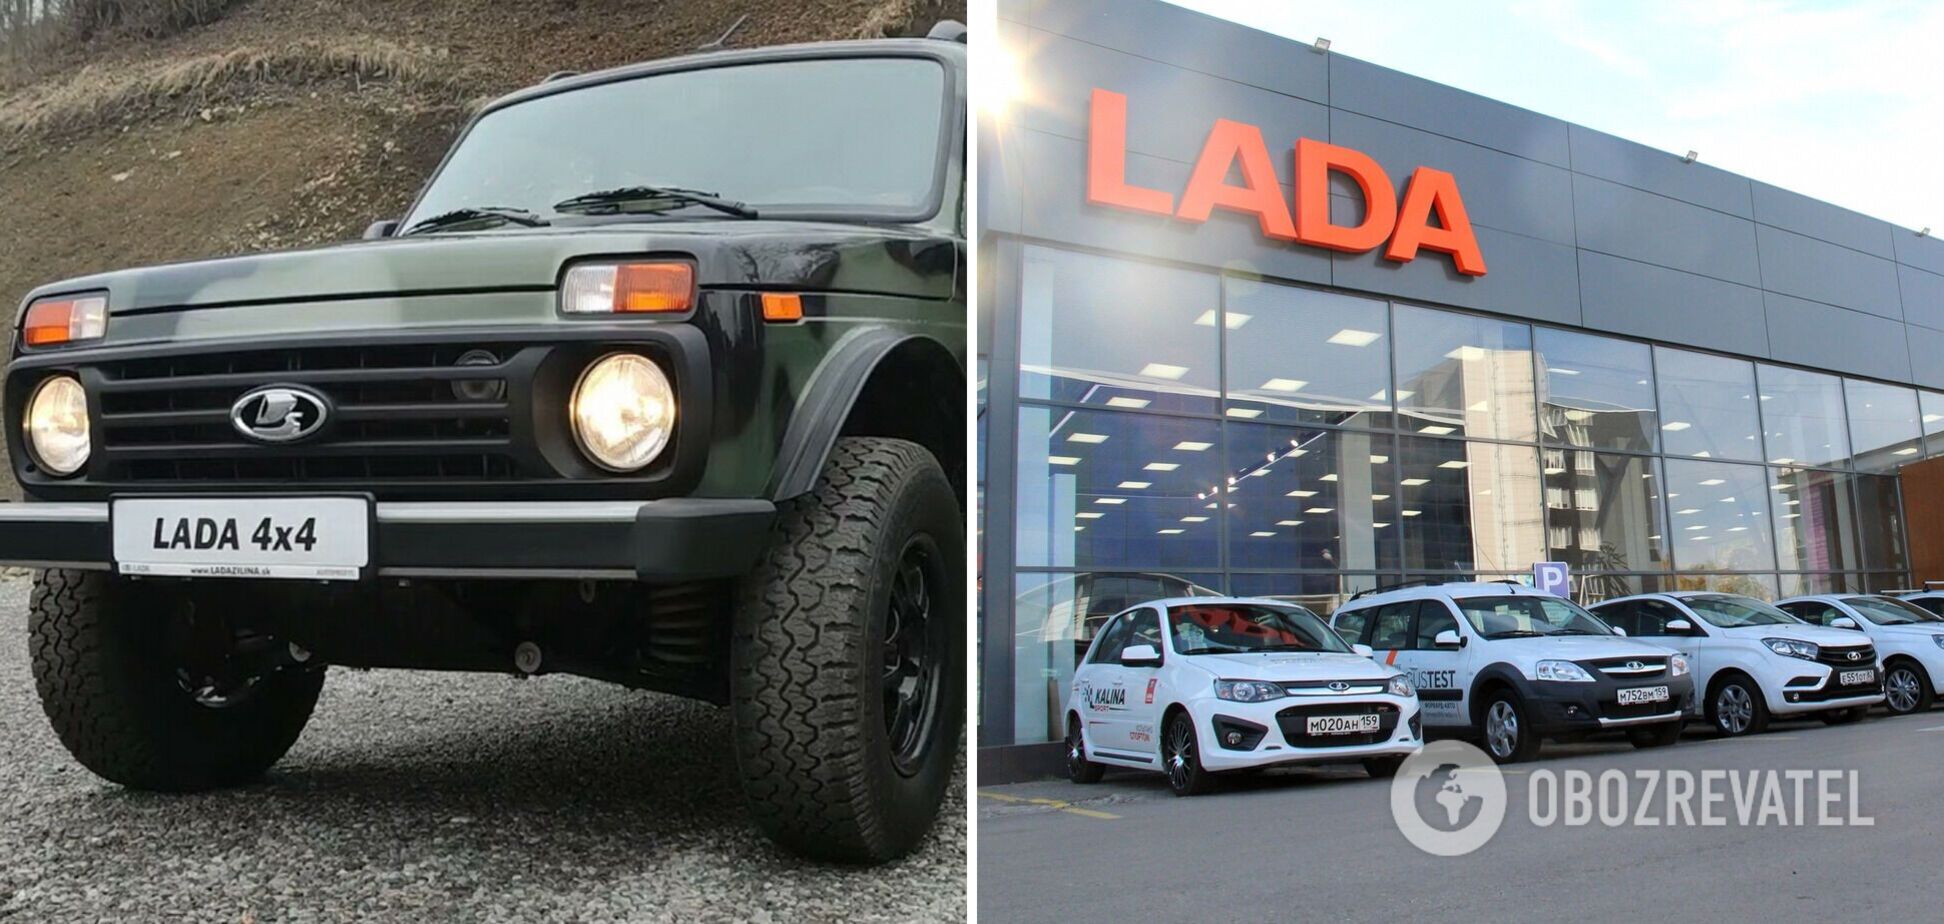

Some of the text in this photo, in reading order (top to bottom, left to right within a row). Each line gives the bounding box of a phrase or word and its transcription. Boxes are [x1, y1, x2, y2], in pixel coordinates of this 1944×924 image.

[1087, 87, 1487, 277] LADA
[153, 517, 317, 551] LADA 4x4
[1542, 567, 1562, 592] P
[1095, 688, 1125, 705] KALINA
[1360, 715, 1378, 726] 159
